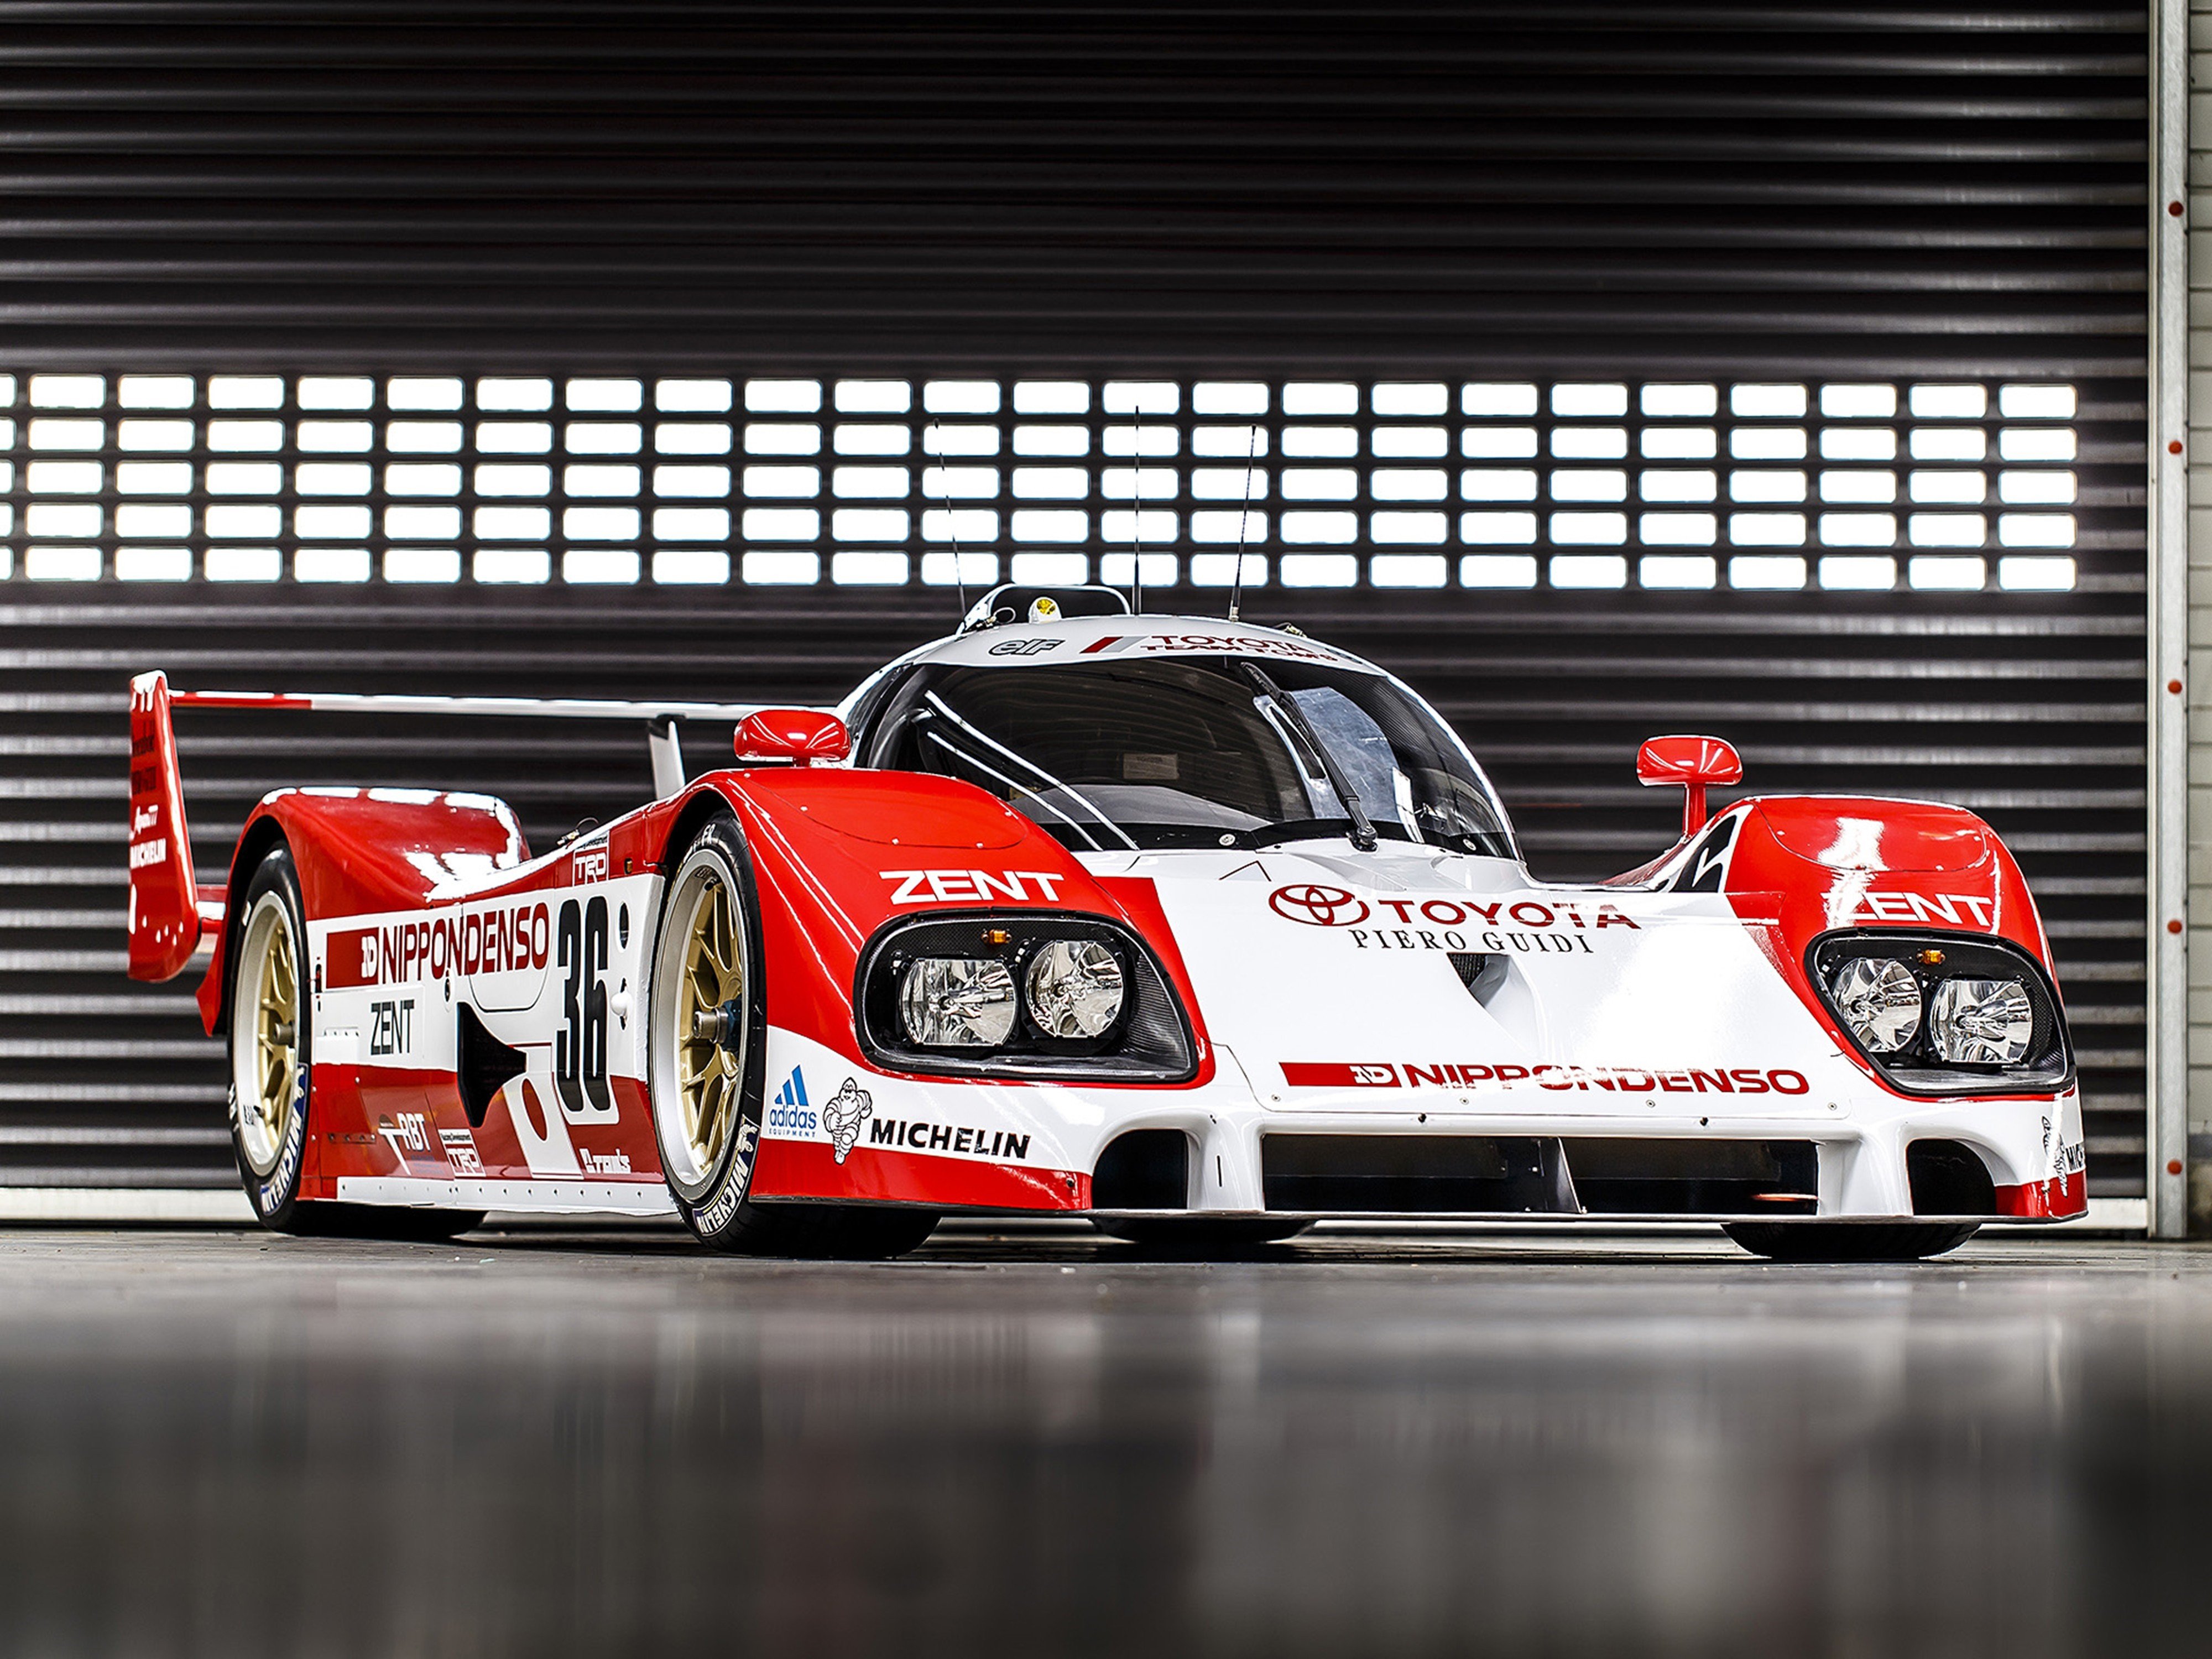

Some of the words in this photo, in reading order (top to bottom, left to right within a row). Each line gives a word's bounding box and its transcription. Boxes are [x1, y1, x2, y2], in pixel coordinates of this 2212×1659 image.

[1151, 635, 1316, 654] TOYOTA
[575, 852, 607, 884] TRD
[878, 870, 1065, 905] ZENT
[1378, 899, 1642, 930] TOYOTA
[1820, 891, 1992, 927] ZENT
[383, 902, 549, 985] NIPPONDENSO
[1347, 929, 1467, 951] PIERO
[1481, 931, 1595, 953] GUIDI
[556, 895, 612, 1113] 36
[371, 999, 415, 1056] ZENT
[1400, 1063, 1810, 1095] NIPPONDENSO
[396, 1113, 431, 1151] RBT
[769, 1104, 817, 1129] adidas
[769, 1128, 816, 1138] EQUIPMENT
[870, 1117, 1031, 1160] MICHELIN
[447, 1148, 480, 1175] TRD
[697, 1154, 749, 1233] MICHELIN
